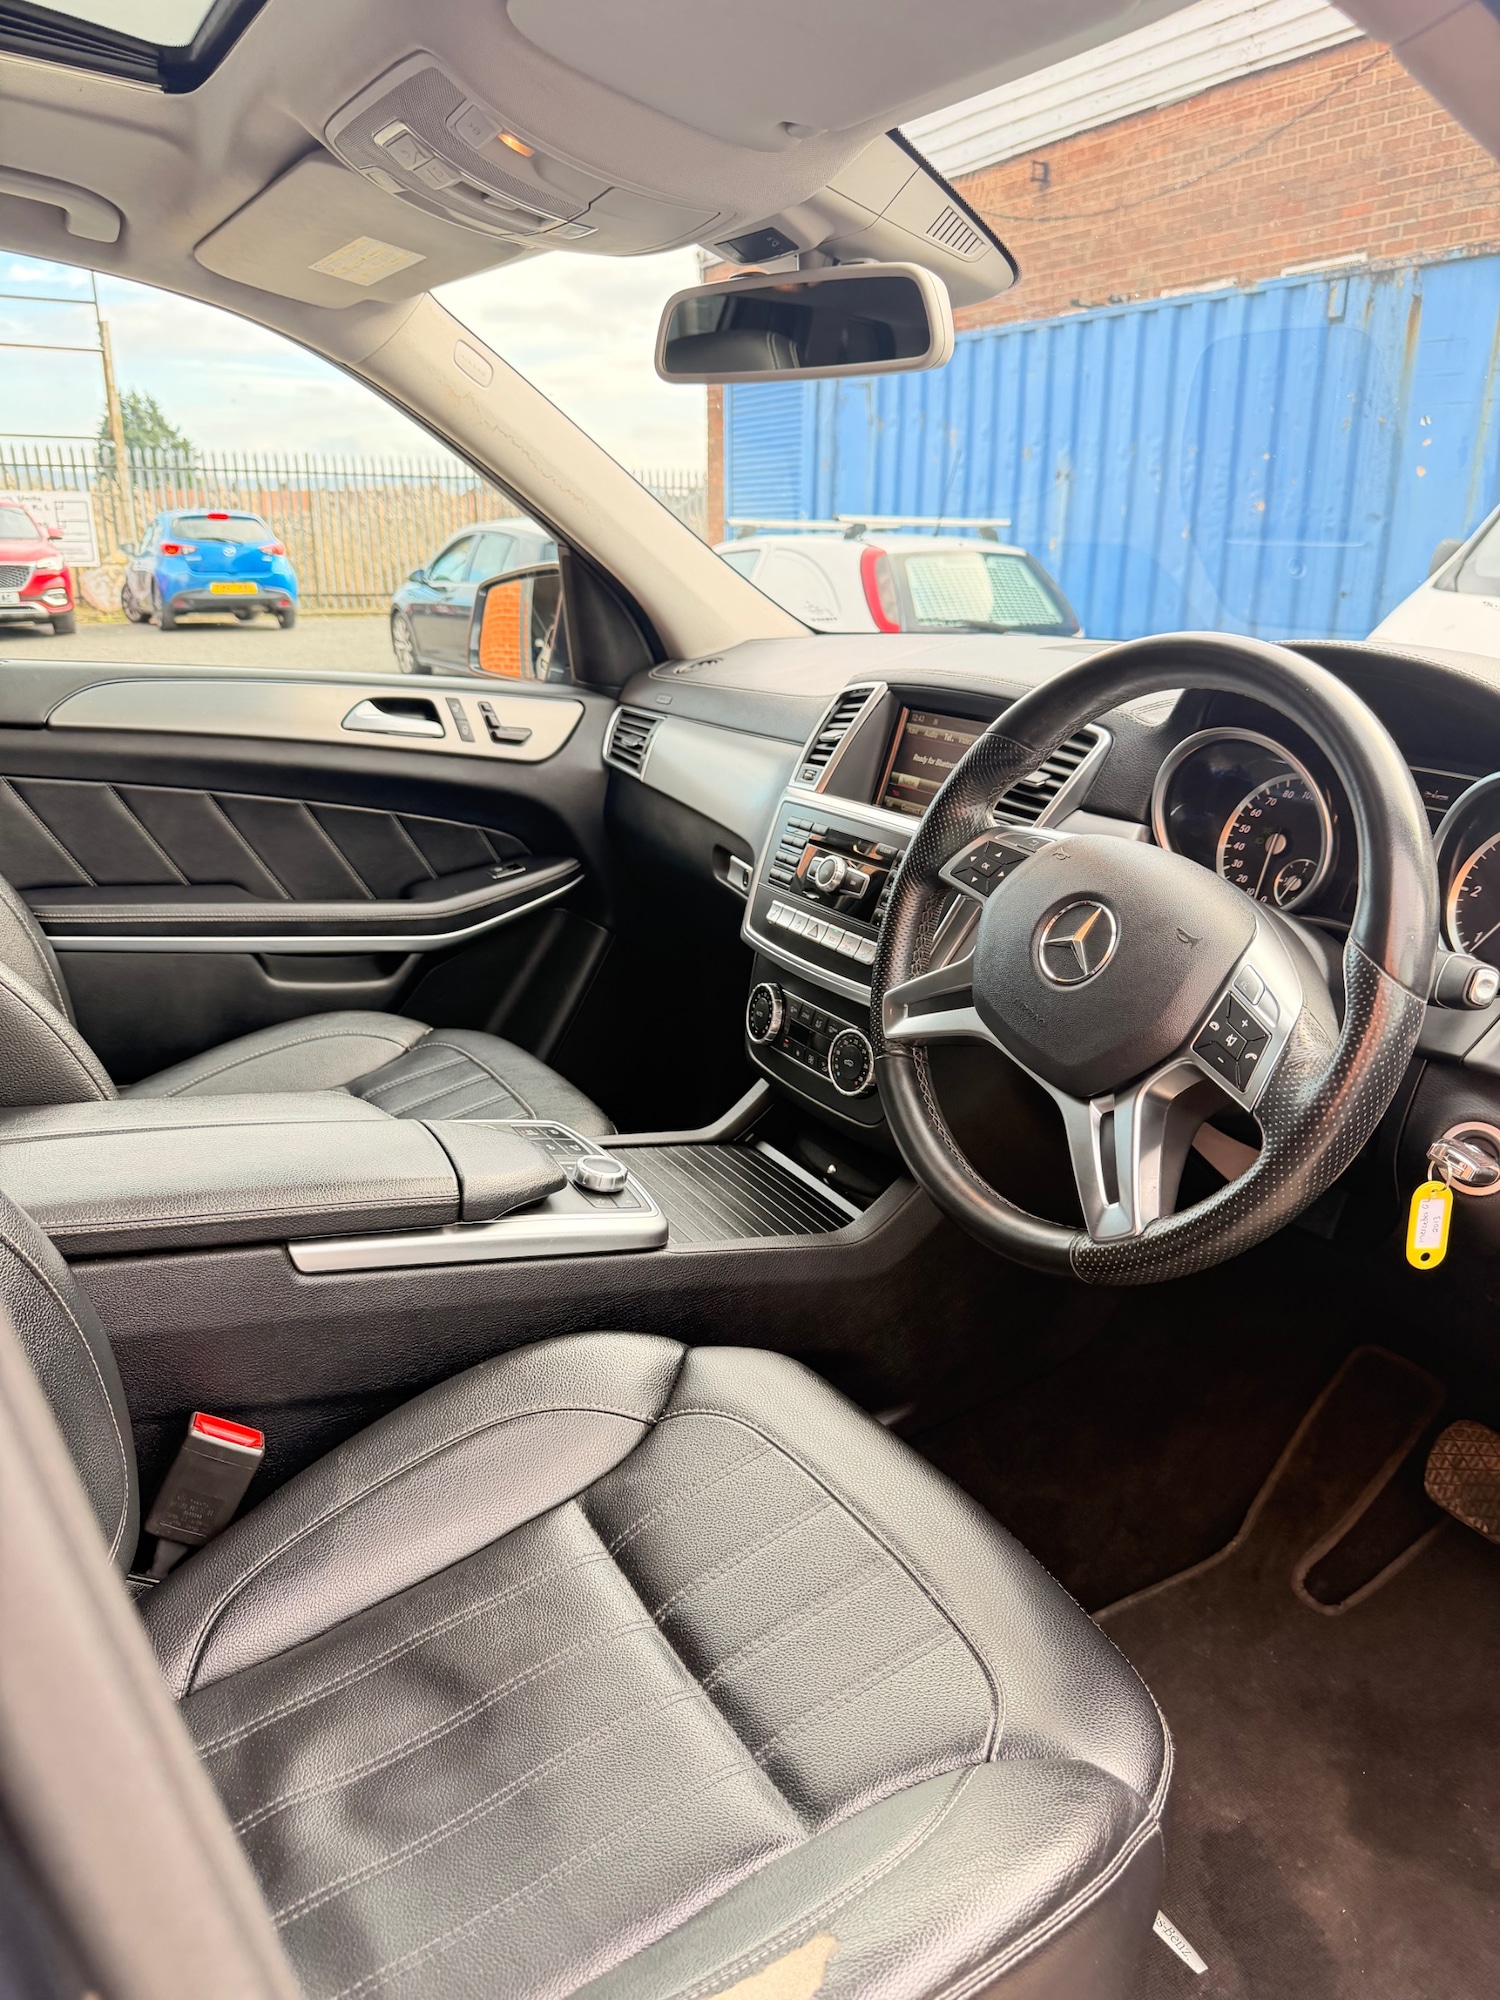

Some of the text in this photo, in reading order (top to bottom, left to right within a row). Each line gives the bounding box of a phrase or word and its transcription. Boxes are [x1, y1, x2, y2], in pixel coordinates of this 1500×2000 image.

[944, 733, 955, 742] Tel.
[912, 753, 929, 765] Ready
[927, 756, 937, 765] for
[1282, 790, 1295, 799] 80
[1265, 797, 1277, 806] 70
[1250, 808, 1262, 818] 60
[1238, 824, 1251, 834] 50
[1233, 842, 1246, 851] 40
[981, 862, 991, 871] OK
[1231, 859, 1244, 868] 30
[1236, 874, 1248, 883] 20
[1470, 885, 1482, 898] 2
[1260, 895, 1268, 903] 0
[1473, 931, 1483, 943] 1
[1432, 1216, 1441, 1233] 2013
